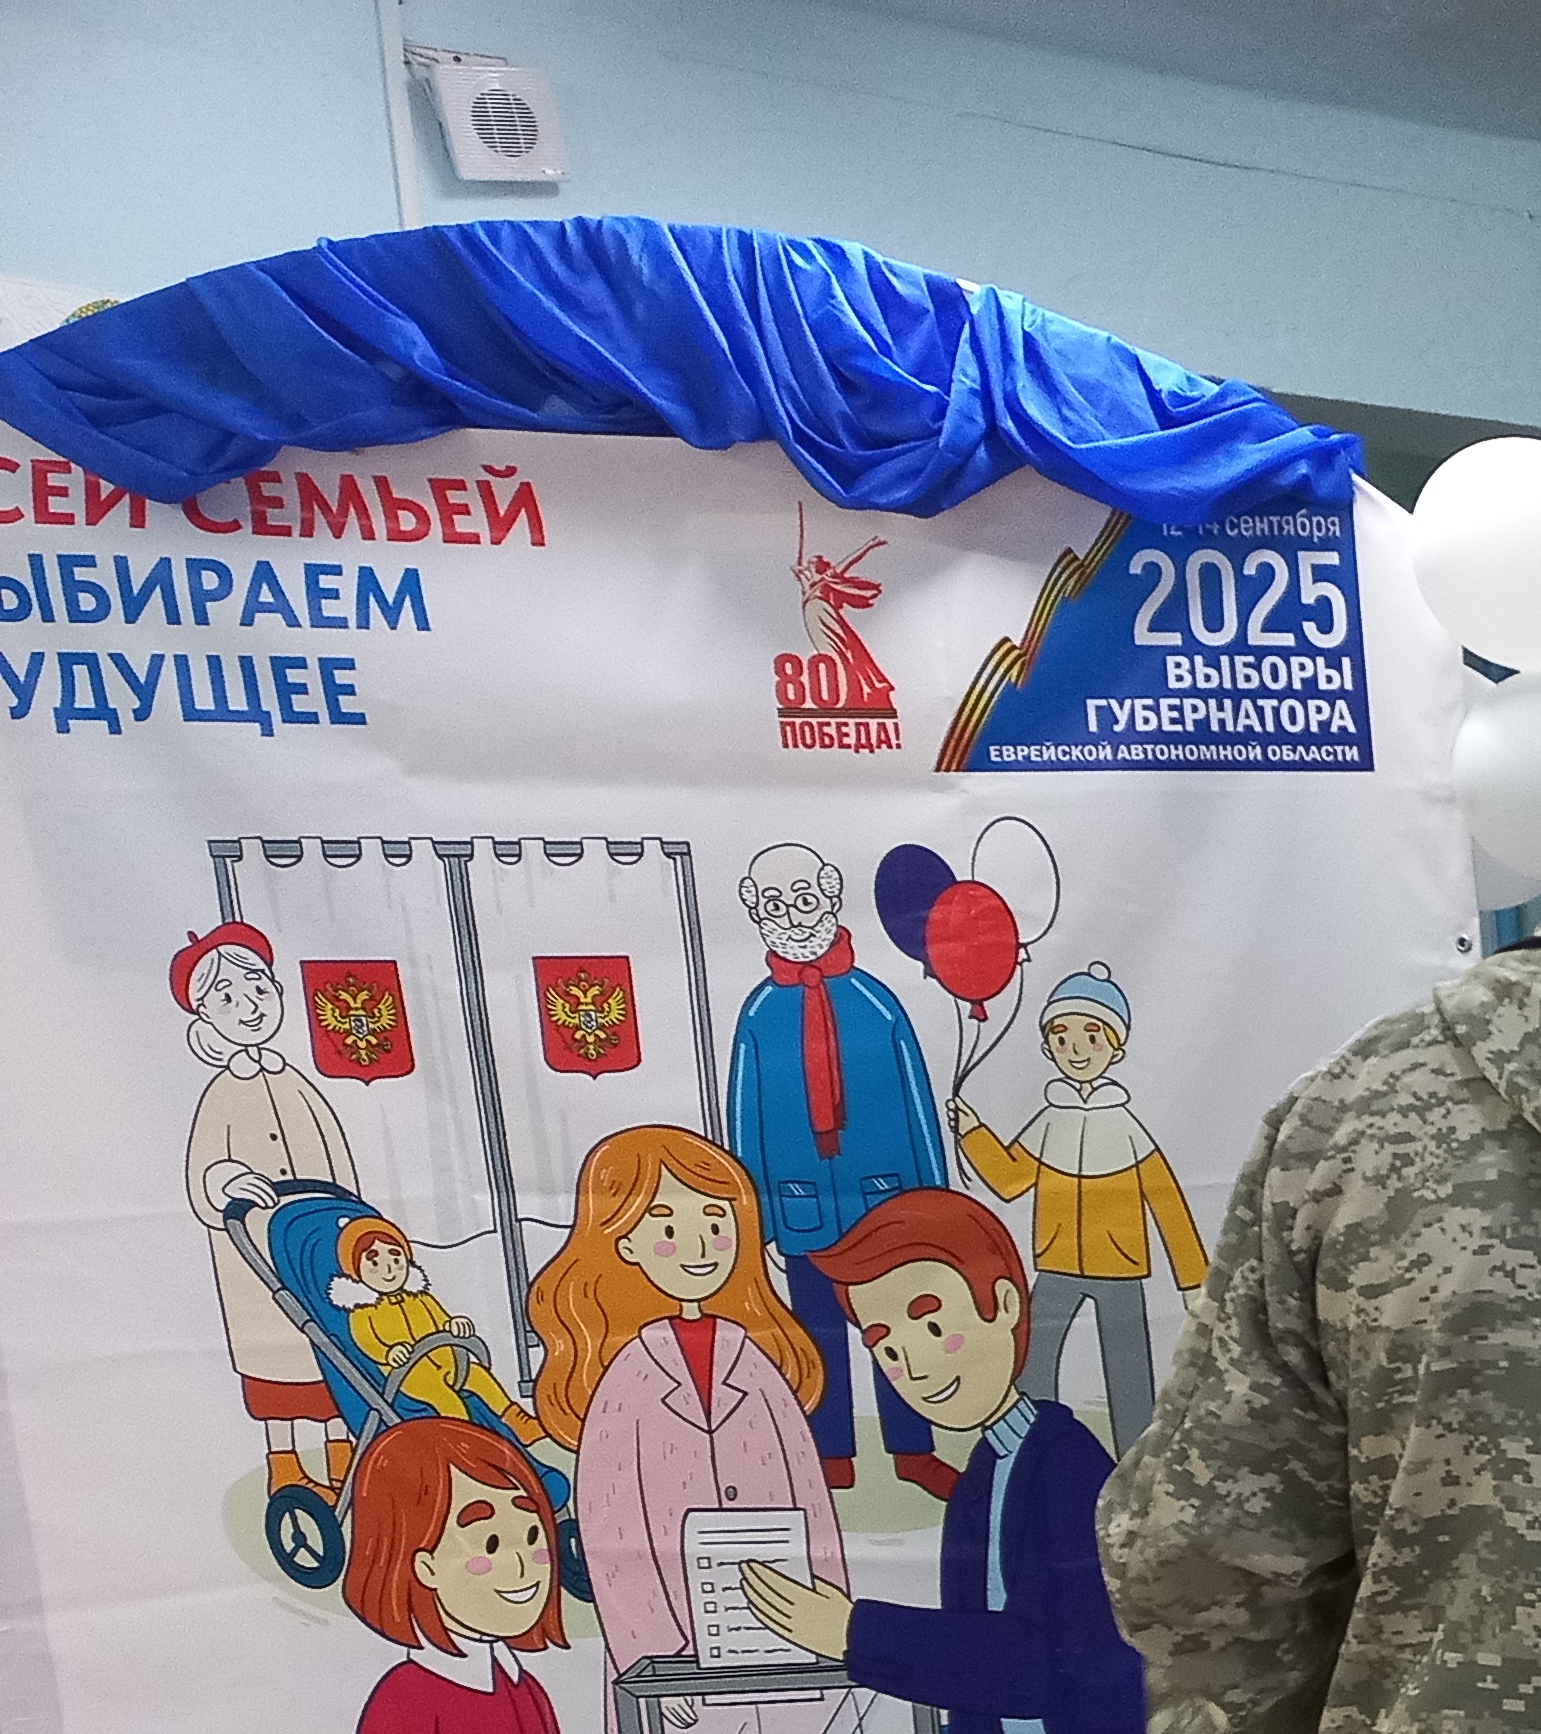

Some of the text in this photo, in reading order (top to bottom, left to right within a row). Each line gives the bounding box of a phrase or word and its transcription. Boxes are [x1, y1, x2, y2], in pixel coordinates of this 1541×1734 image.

[181, 464, 547, 547] СЕМЬЕЙ
[1224, 508, 1341, 543] сентября
[1129, 548, 1349, 648] 2025
[773, 653, 841, 709] 80
[1166, 655, 1355, 691] ВЫБОРЫ
[1085, 698, 1357, 734] ГУБЕРНАТОРА
[779, 720, 902, 754] ПОБЕДА!
[989, 740, 1360, 763] ЕВРЕЙСКОЙ АВТОНОМНОЙ ОБЛАСТИ
